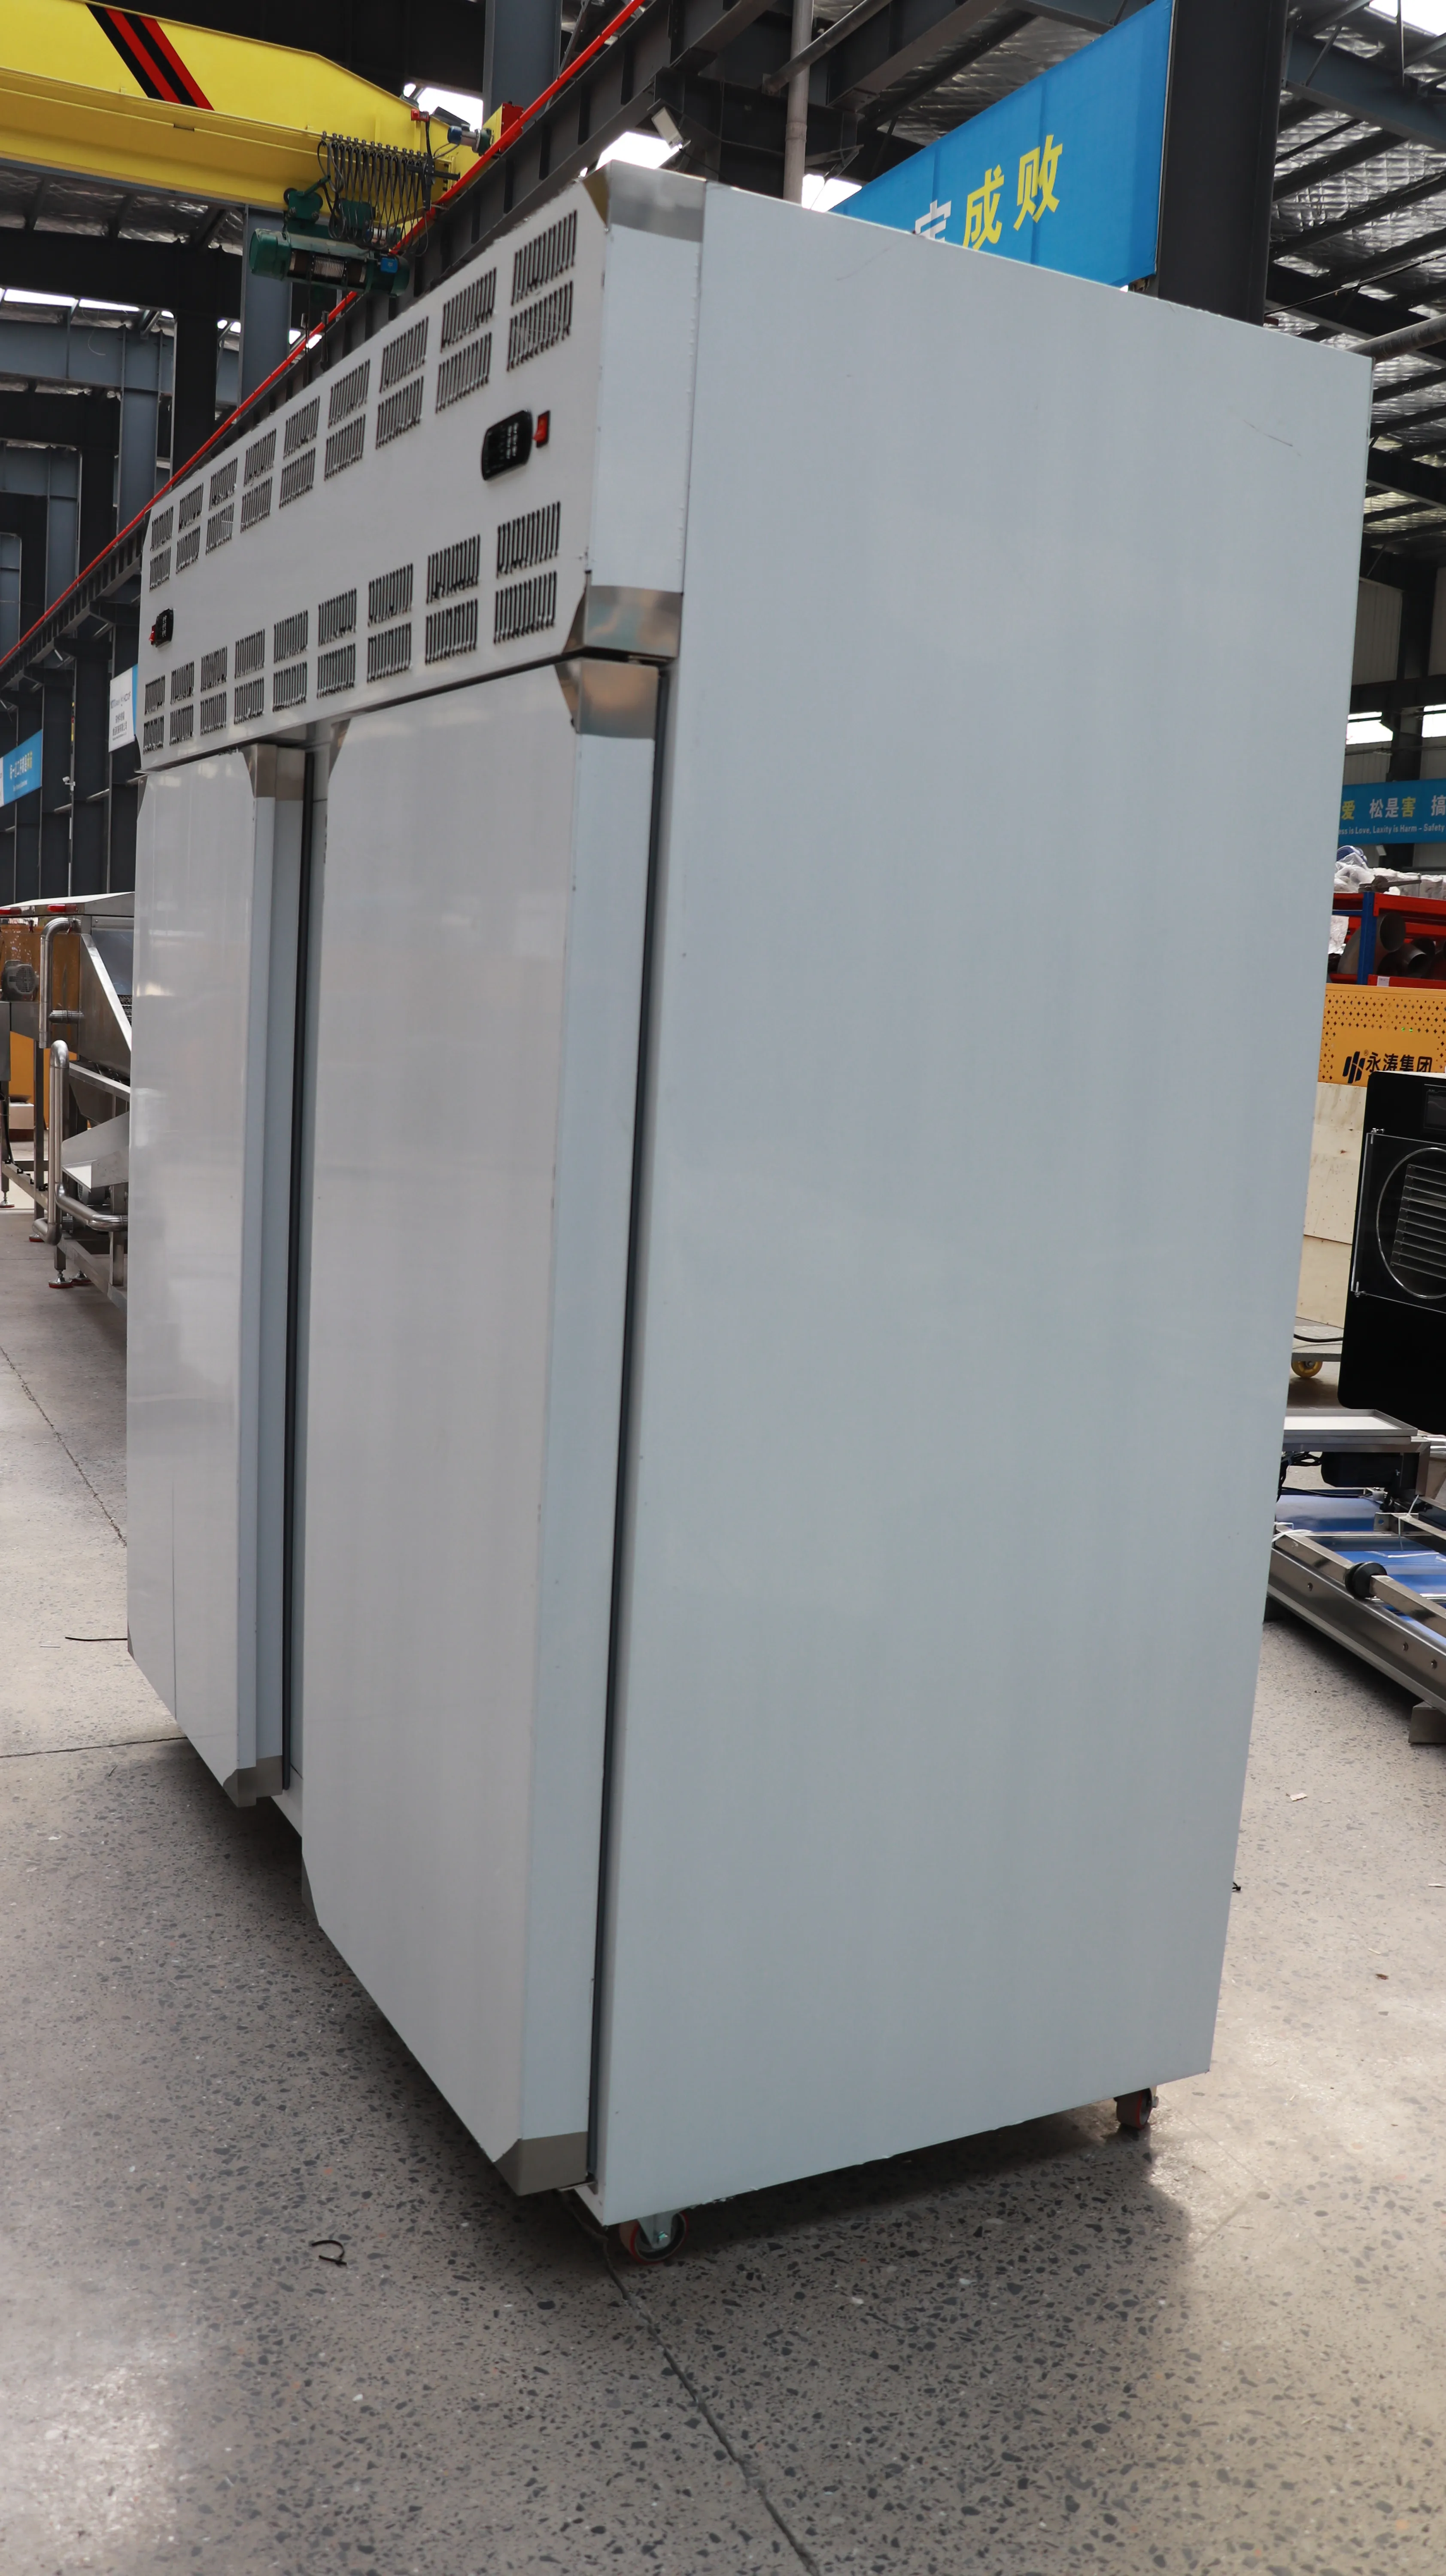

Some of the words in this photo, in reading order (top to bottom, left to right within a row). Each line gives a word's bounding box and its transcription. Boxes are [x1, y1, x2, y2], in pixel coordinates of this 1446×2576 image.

[1341, 800, 1355, 820] 爱
[1369, 796, 1416, 819] 松是害
[1431, 795, 1446, 816] 搞
[1373, 825, 1391, 834] Laxity
[1423, 823, 1445, 832] Safety
[1365, 1051, 1432, 1072] 永涛集团
